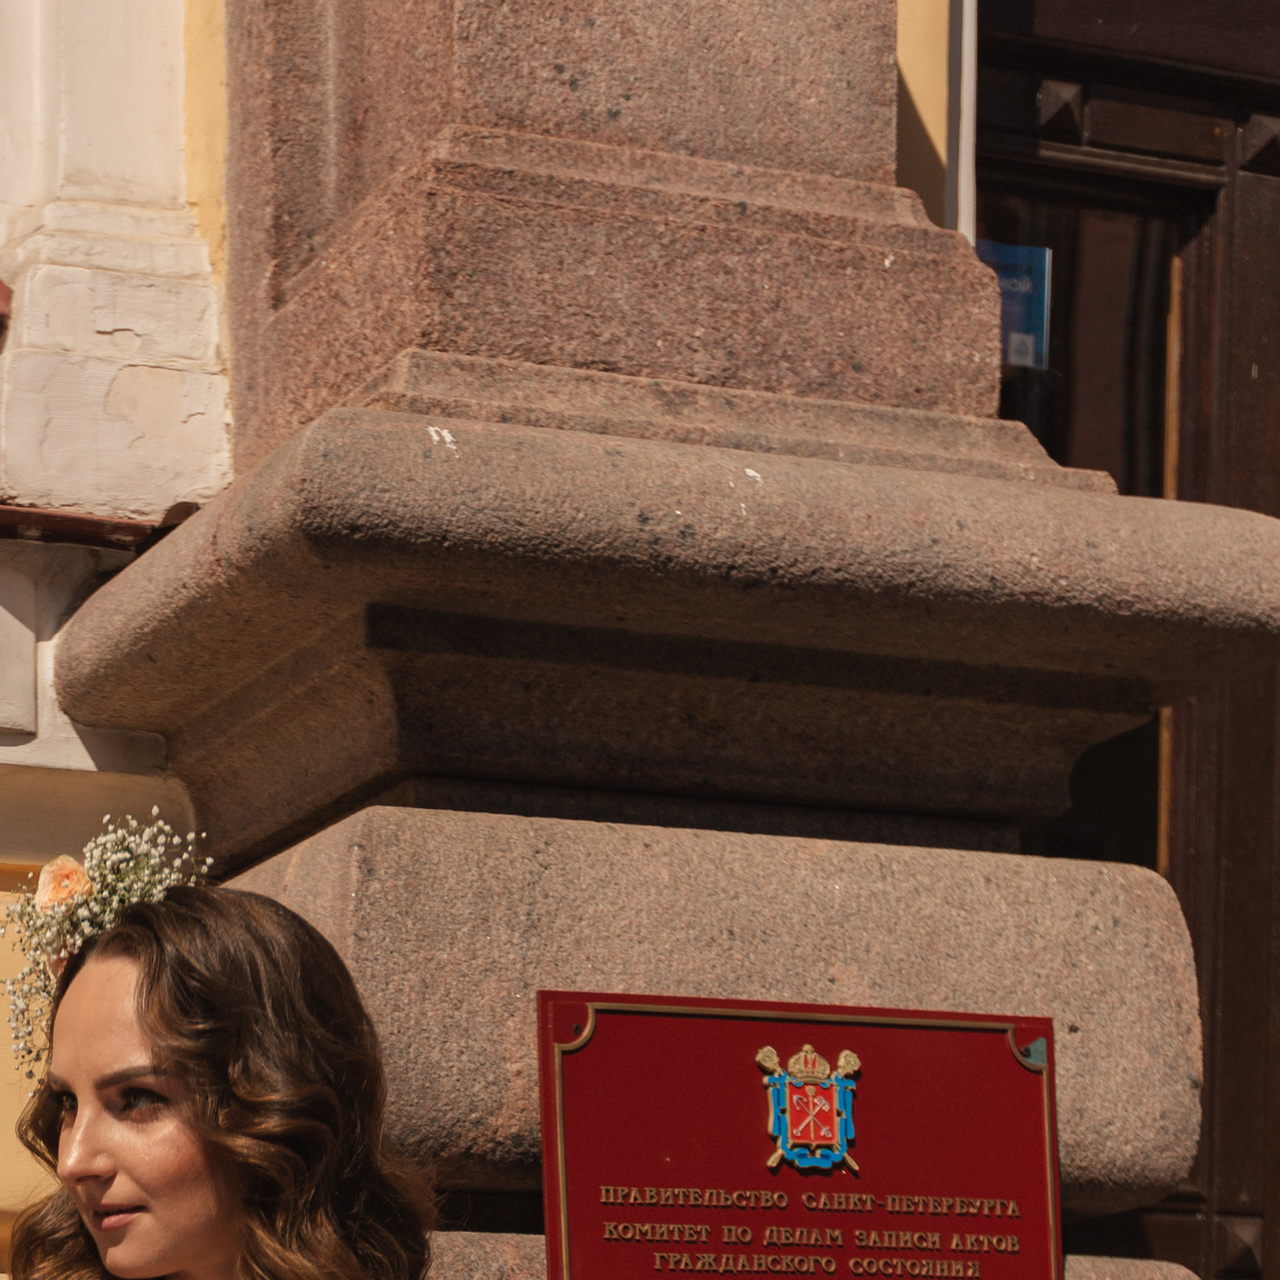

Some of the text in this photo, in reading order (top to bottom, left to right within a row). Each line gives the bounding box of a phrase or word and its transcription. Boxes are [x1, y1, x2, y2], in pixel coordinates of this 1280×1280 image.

[600, 1186, 1021, 1217] ПРАВИТЕЛЬСТВО САНКТ-ПЕТЕРБУРГА
[603, 1222, 1020, 1253] КОМИТЕТ ПО ДЕЛАМ ЗАПИСИ АКТОВ
[654, 1252, 981, 1279] ГРАЖДАНСКОГО СОСТОЯНИЯ
